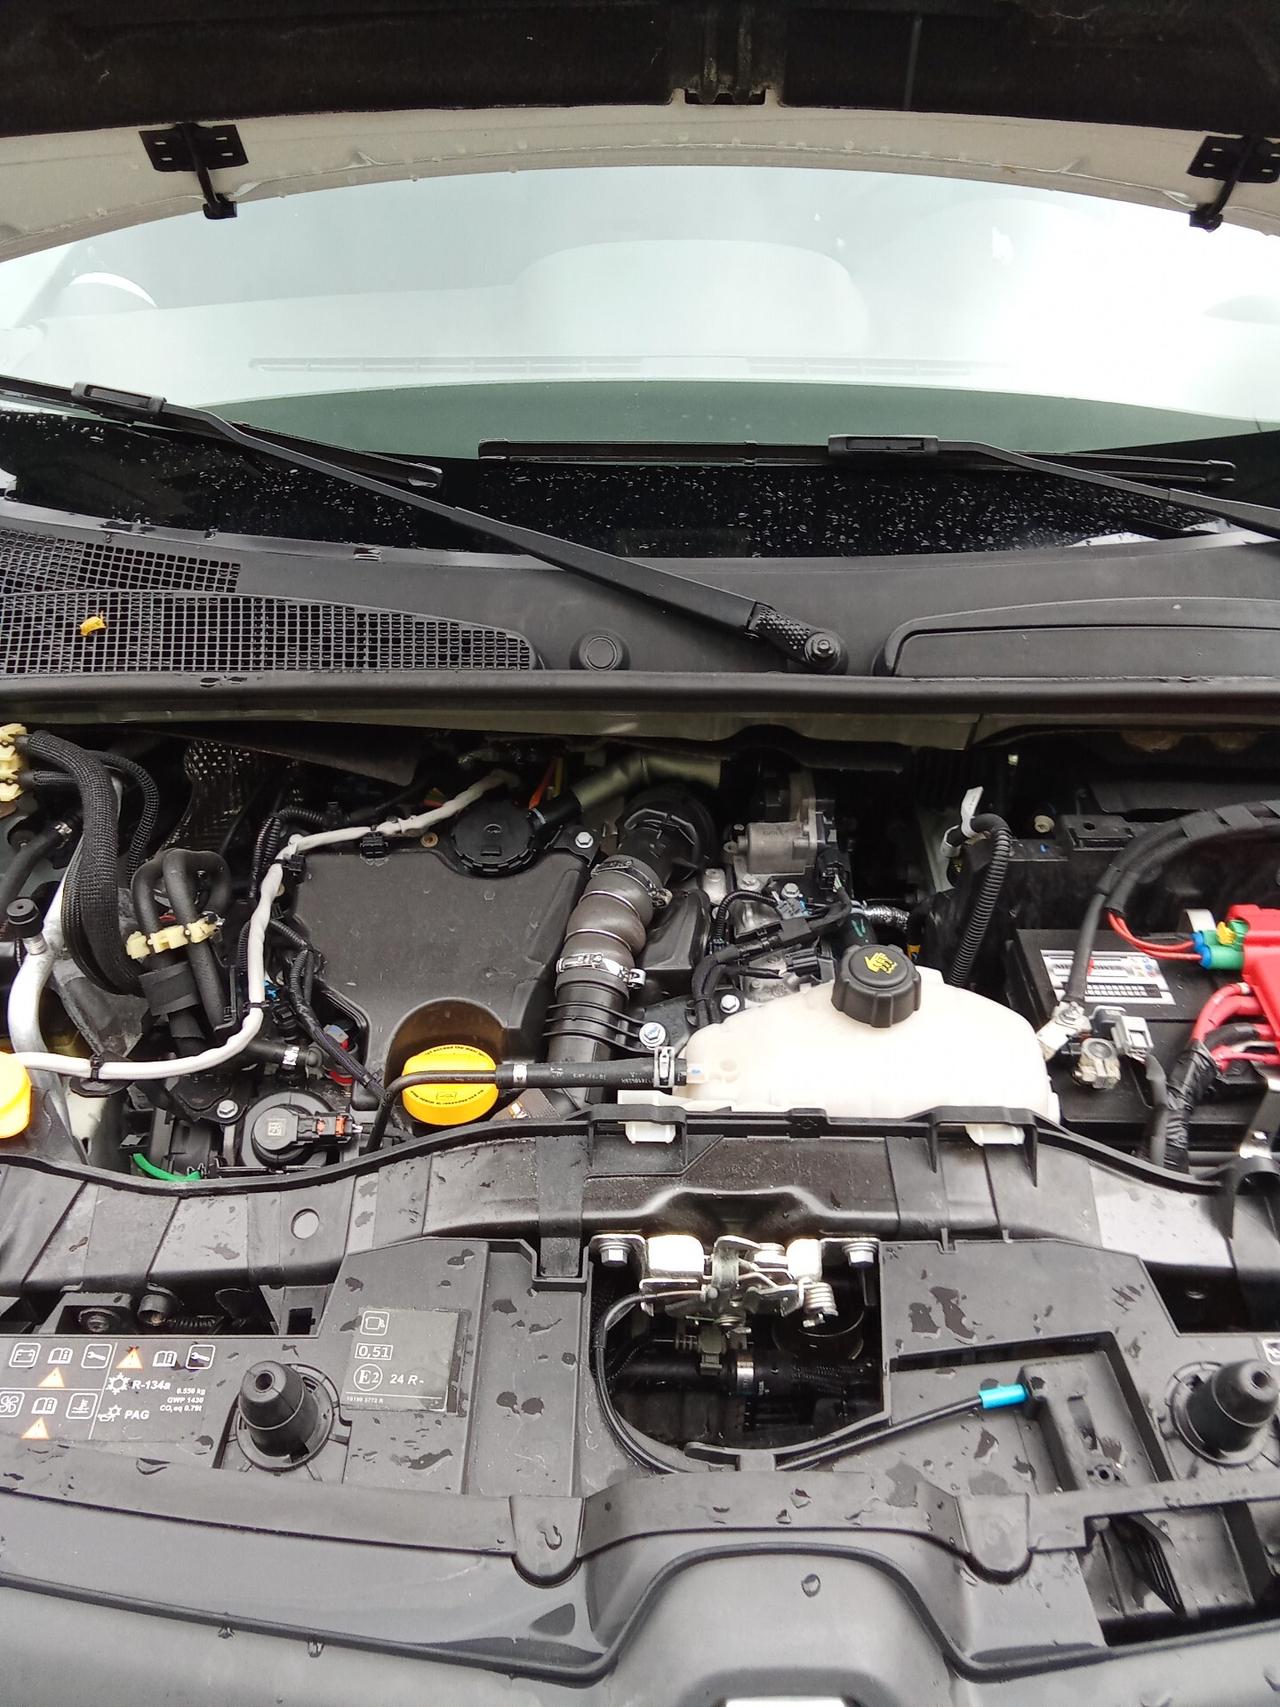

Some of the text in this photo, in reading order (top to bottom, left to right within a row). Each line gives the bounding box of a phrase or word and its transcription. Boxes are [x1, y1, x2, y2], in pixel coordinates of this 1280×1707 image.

[358, 1345, 389, 1358] 0,51
[358, 1369, 380, 1385] E2
[389, 1374, 404, 1385] 24
[132, 1380, 171, 1390] R-134a
[124, 1410, 150, 1420] PAG
